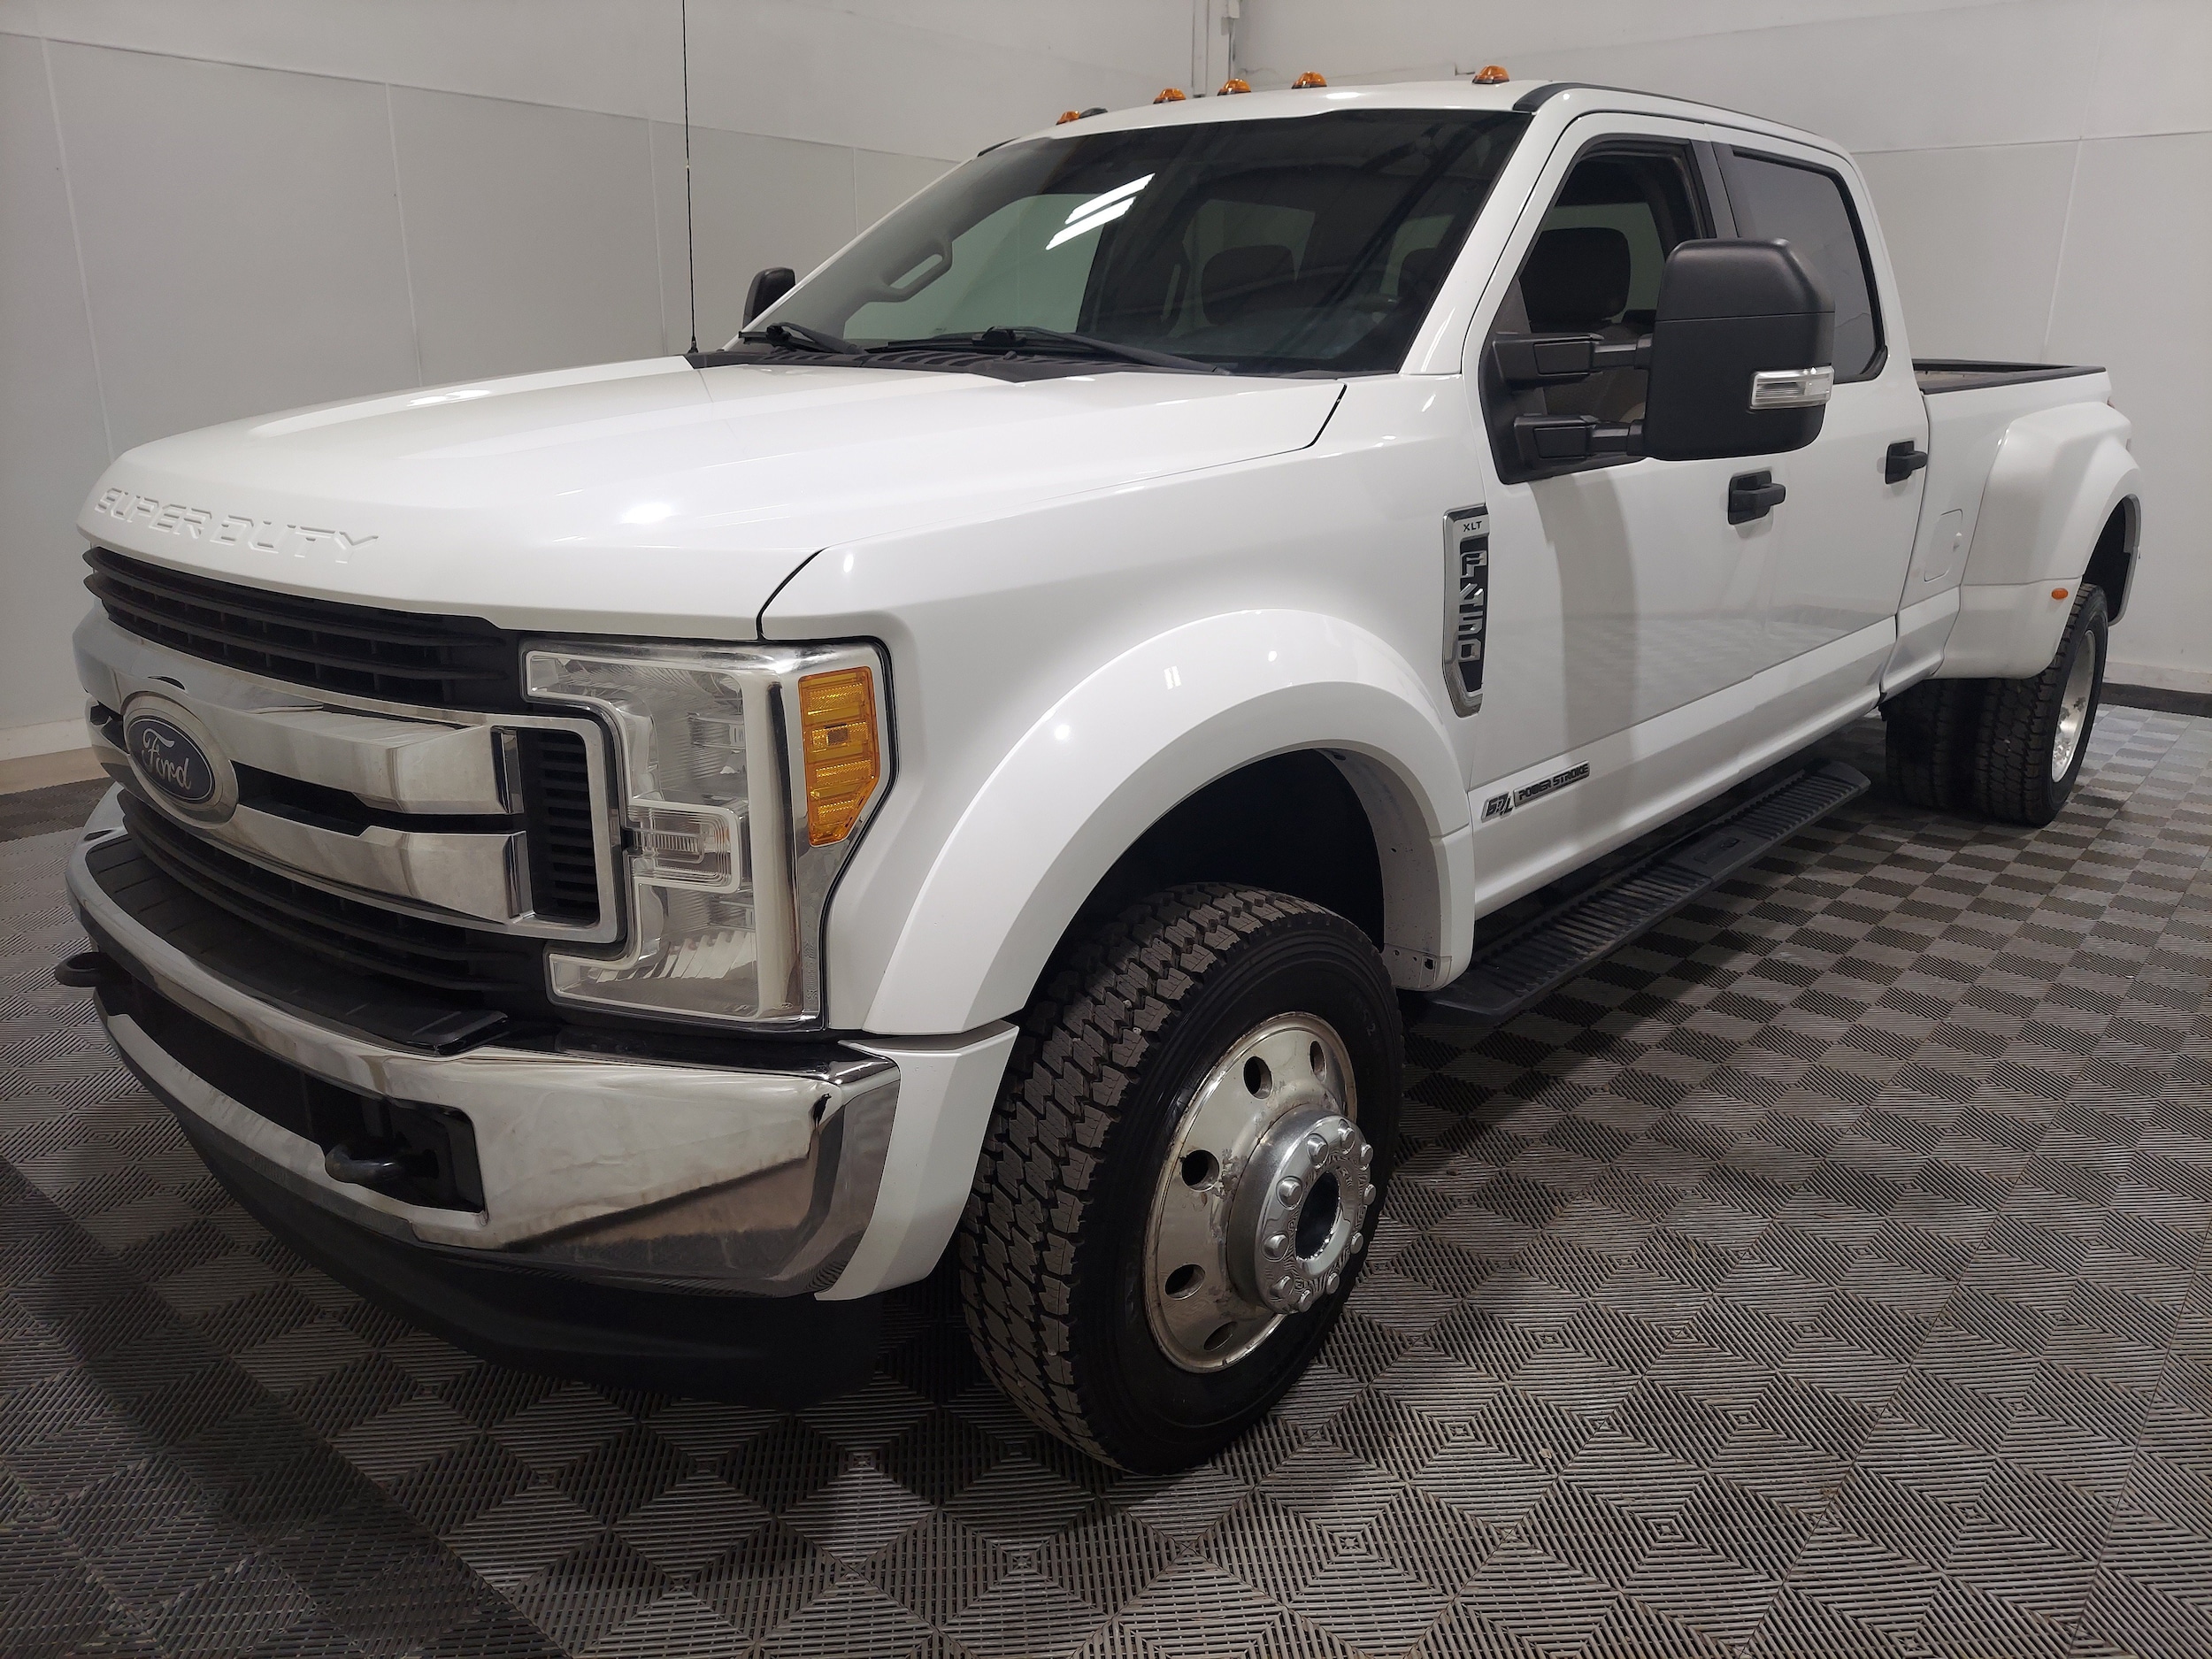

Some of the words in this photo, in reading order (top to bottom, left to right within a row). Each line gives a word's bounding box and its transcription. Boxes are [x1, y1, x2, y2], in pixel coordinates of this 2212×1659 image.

[95, 488, 212, 540] SUPER
[210, 513, 380, 564] DUTY
[1463, 520, 1483, 533] XLT
[142, 727, 192, 790] Ford
[1518, 780, 1552, 801] POWER
[1552, 763, 1589, 787] STROKE
